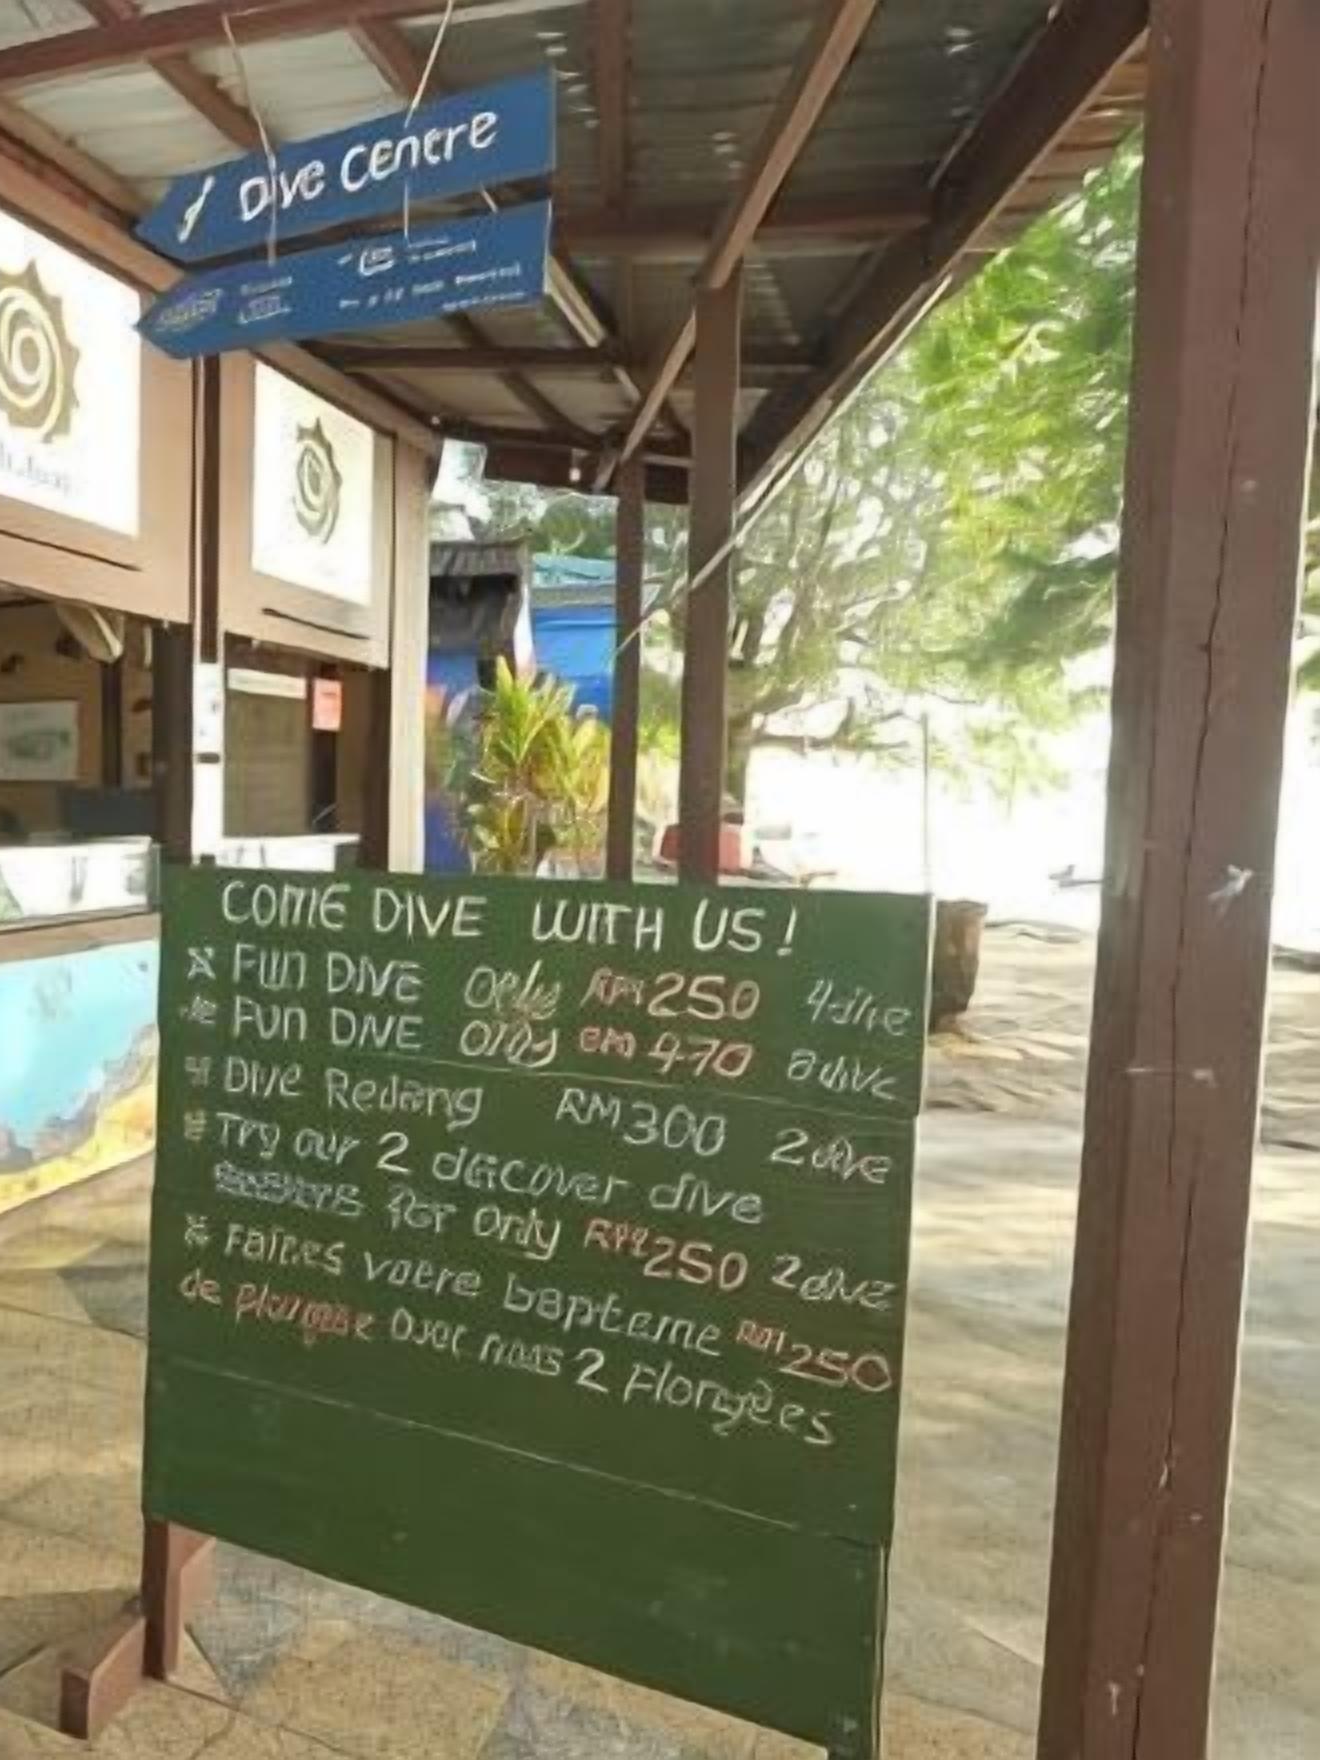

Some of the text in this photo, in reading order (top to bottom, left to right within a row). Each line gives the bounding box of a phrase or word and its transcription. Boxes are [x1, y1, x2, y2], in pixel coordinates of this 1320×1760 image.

[239, 111, 499, 223] Dive Centre
[222, 880, 351, 932] COME
[372, 886, 488, 943] DIVE
[532, 898, 664, 952] WITH
[327, 950, 427, 1003] DIVE
[330, 1006, 424, 1050] DIVE
[215, 1112, 281, 1160] Try
[376, 1131, 412, 1175] 2
[648, 1173, 764, 1224] dive
[179, 1269, 223, 1305] de
[573, 1348, 608, 1394] 2
